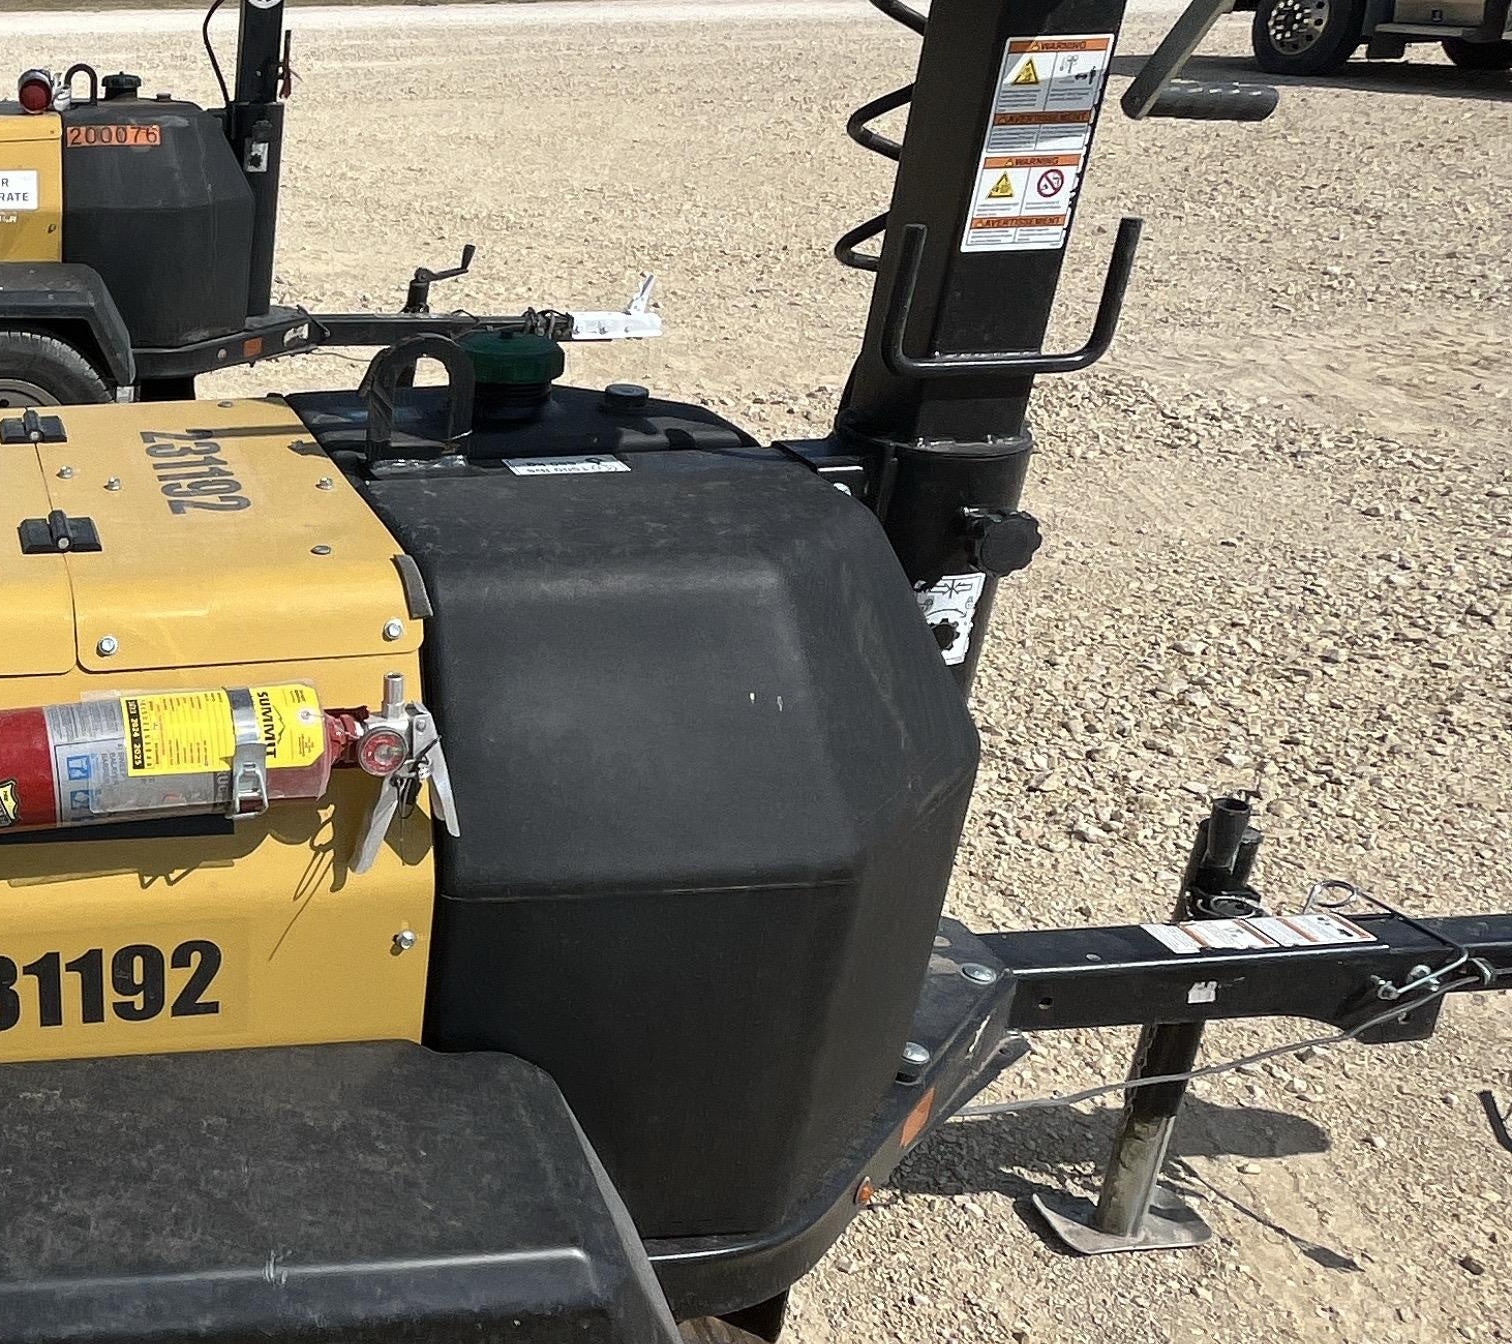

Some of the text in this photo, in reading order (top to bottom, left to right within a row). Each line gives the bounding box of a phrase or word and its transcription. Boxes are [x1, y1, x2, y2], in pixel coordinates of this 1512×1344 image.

[70, 125, 159, 147] 200076
[1015, 157, 1060, 166] WARNING
[139, 431, 251, 515] 231192
[130, 717, 140, 738] 2024
[257, 691, 277, 759] SUMMIT
[133, 742, 143, 766] 2025
